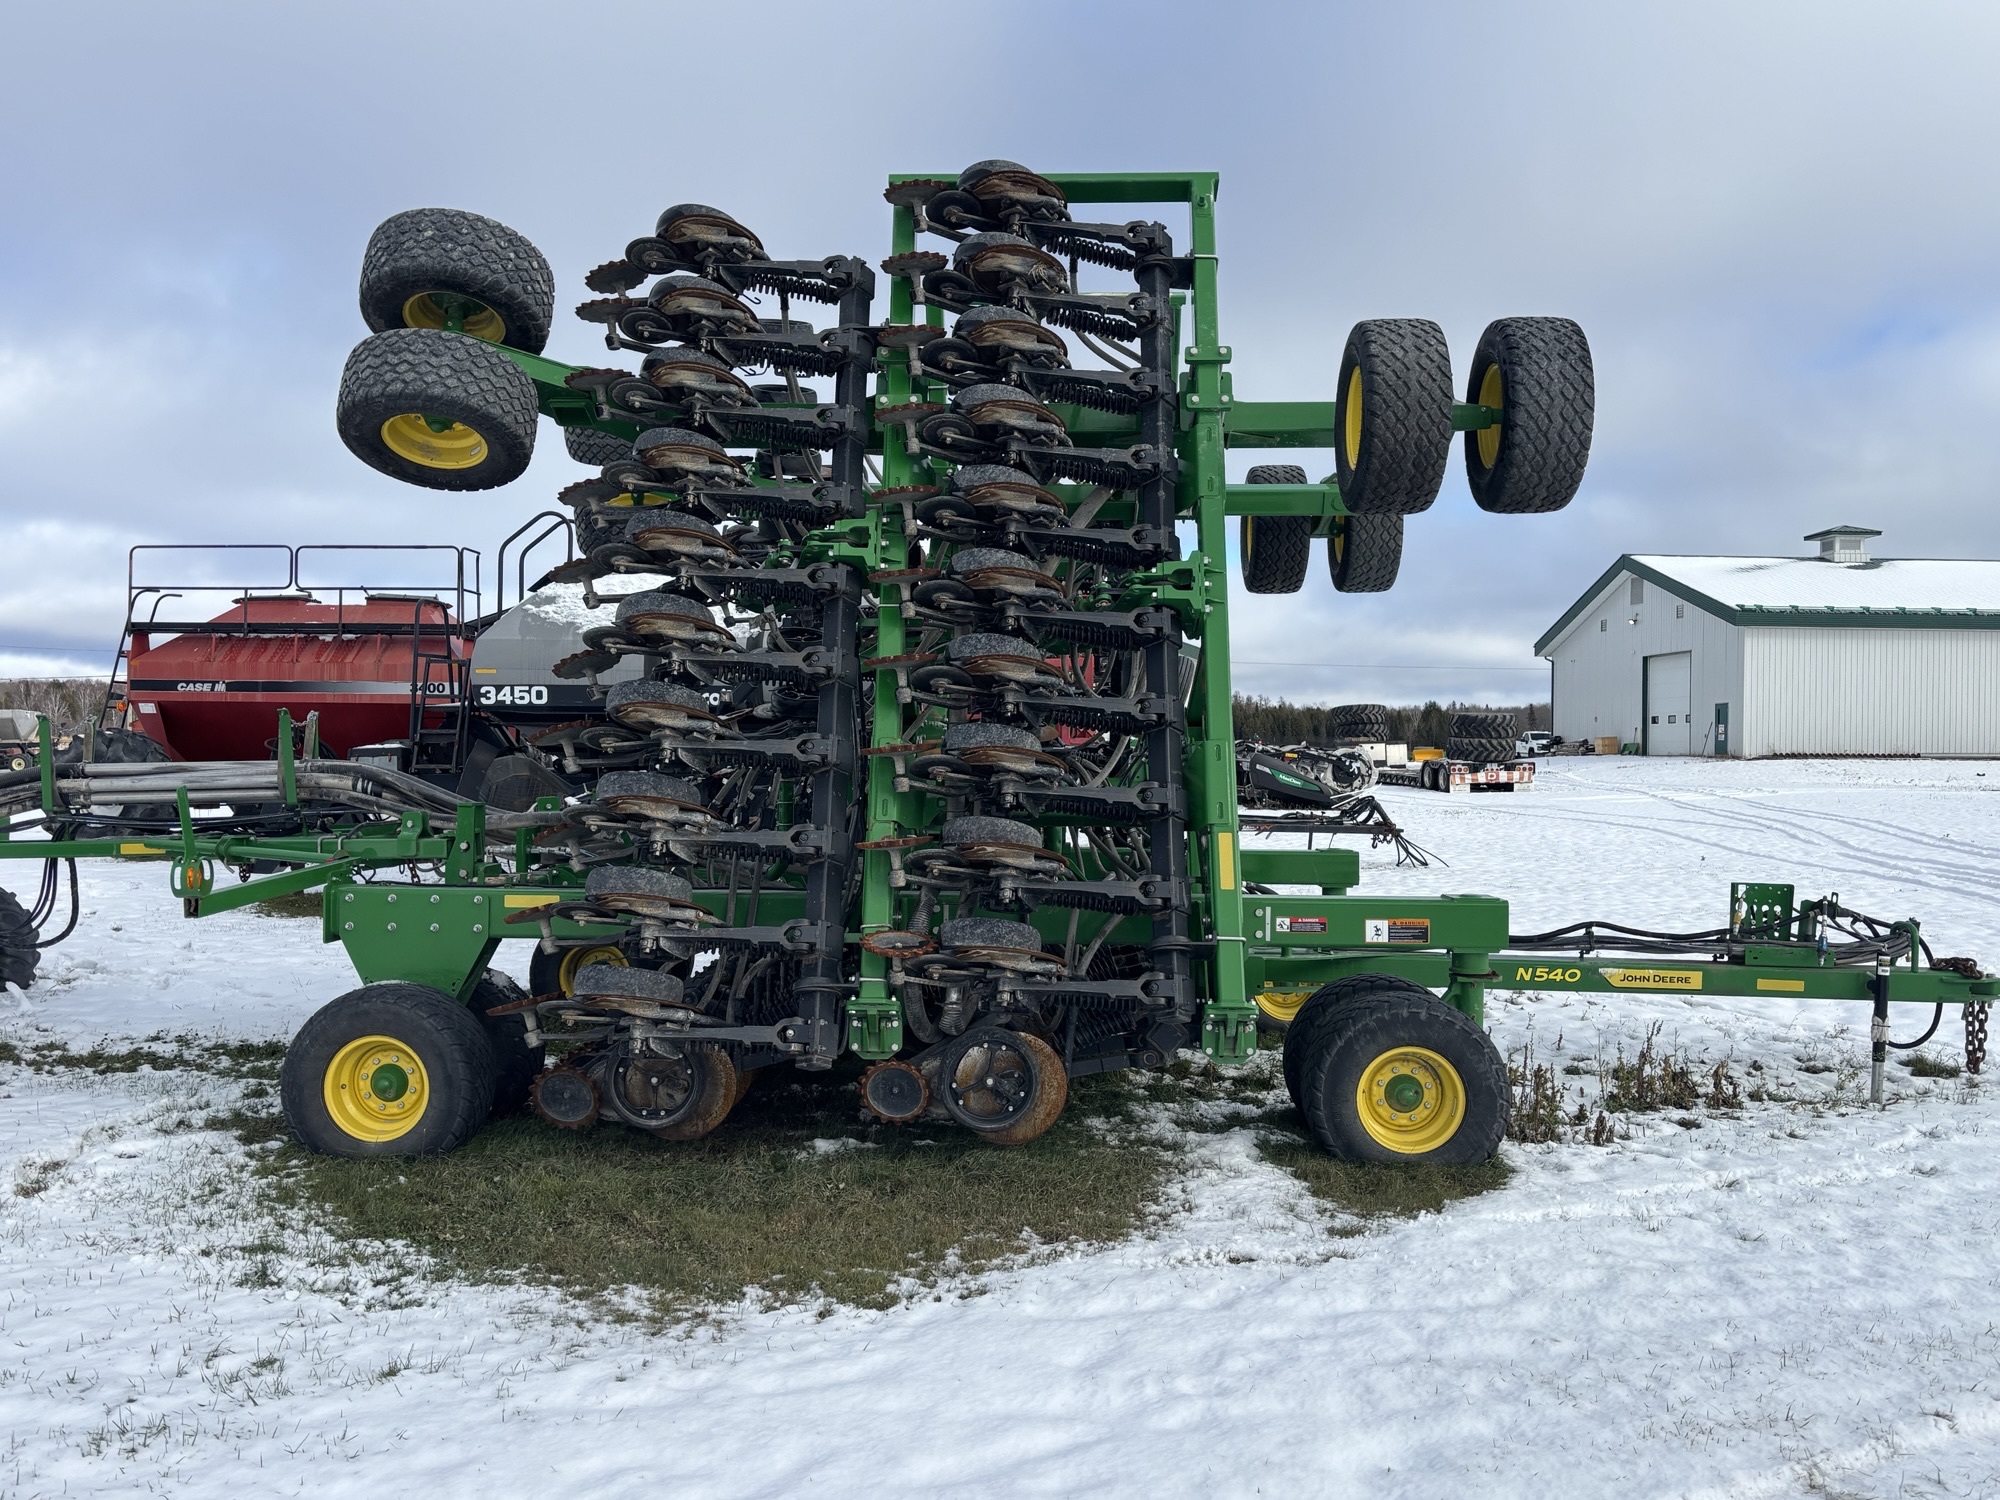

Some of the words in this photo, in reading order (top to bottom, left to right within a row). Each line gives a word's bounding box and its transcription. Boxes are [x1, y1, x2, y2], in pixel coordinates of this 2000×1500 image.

[177, 682, 212, 692] CASE
[480, 686, 548, 705] 3450
[1278, 774, 1302, 786] MacDon
[1515, 967, 1581, 983] N540
[1619, 973, 1650, 983] JOHN
[1652, 974, 1692, 984] DEERE
